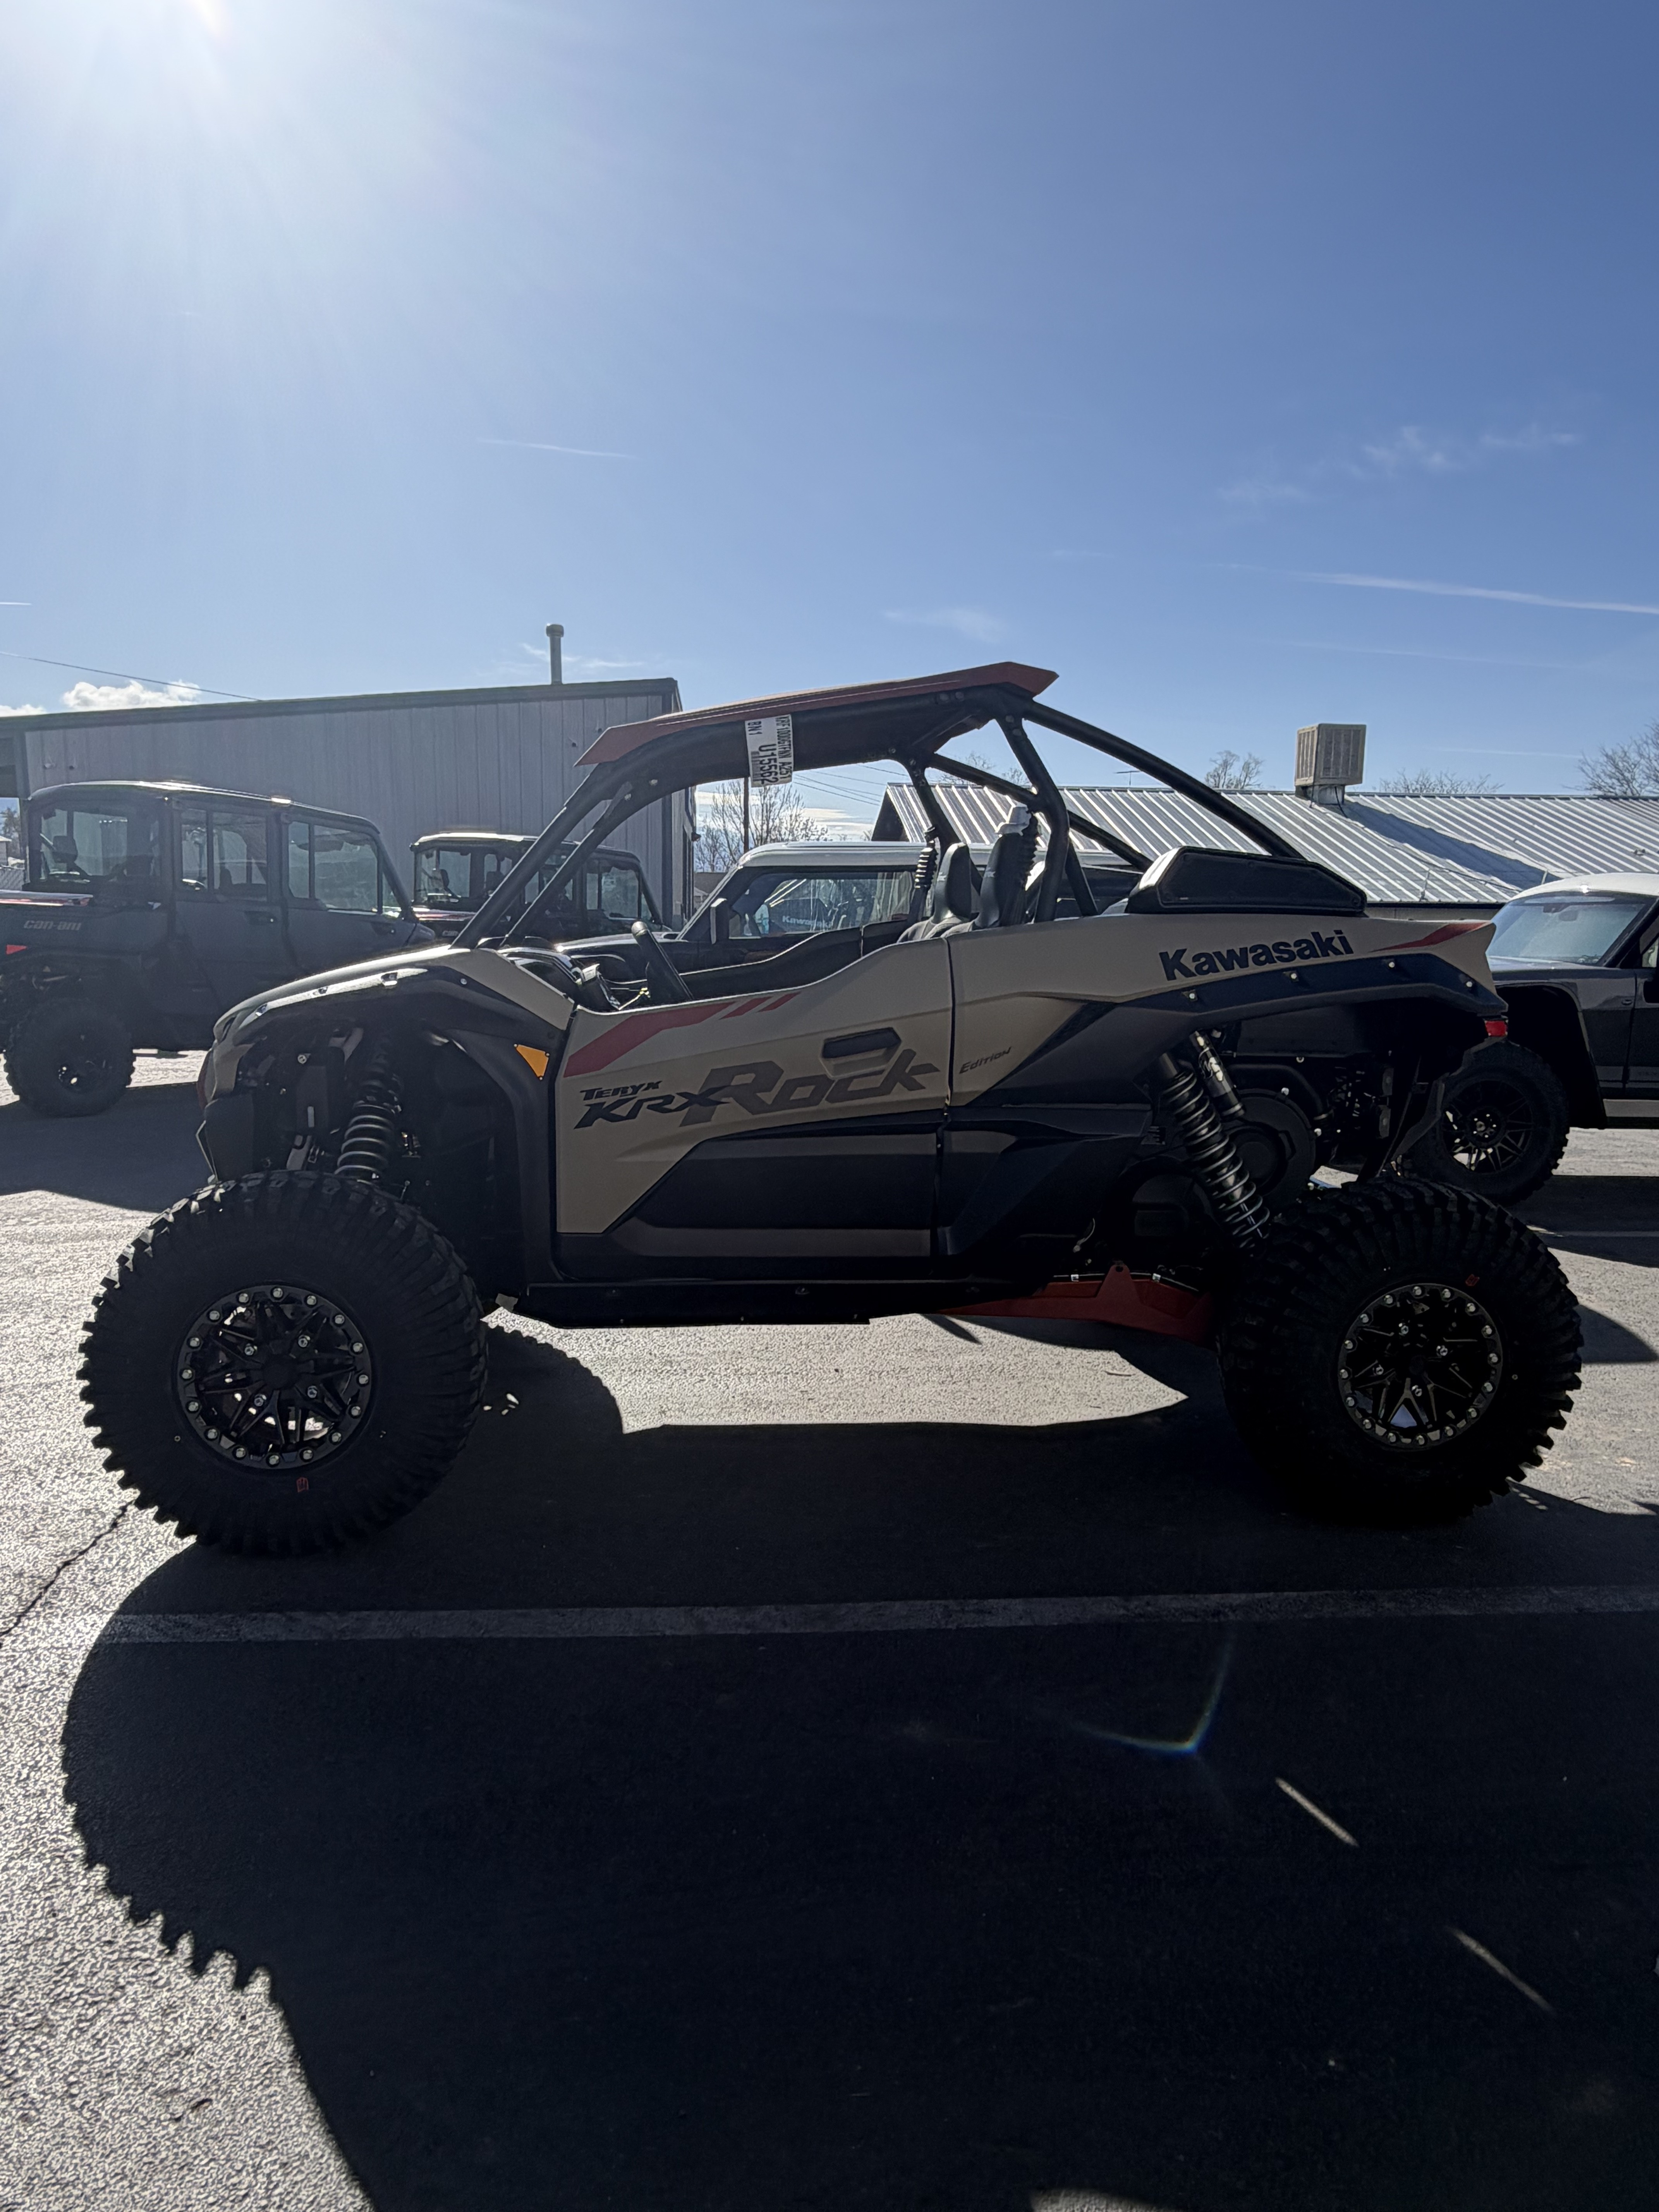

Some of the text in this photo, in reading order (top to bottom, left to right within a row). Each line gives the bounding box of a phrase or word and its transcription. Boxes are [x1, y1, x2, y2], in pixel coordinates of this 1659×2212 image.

[758, 744, 779, 784] U15562
[778, 761, 792, 779] A251
[1159, 929, 1354, 981] Kawasaki
[574, 1081, 732, 1130] KRX
